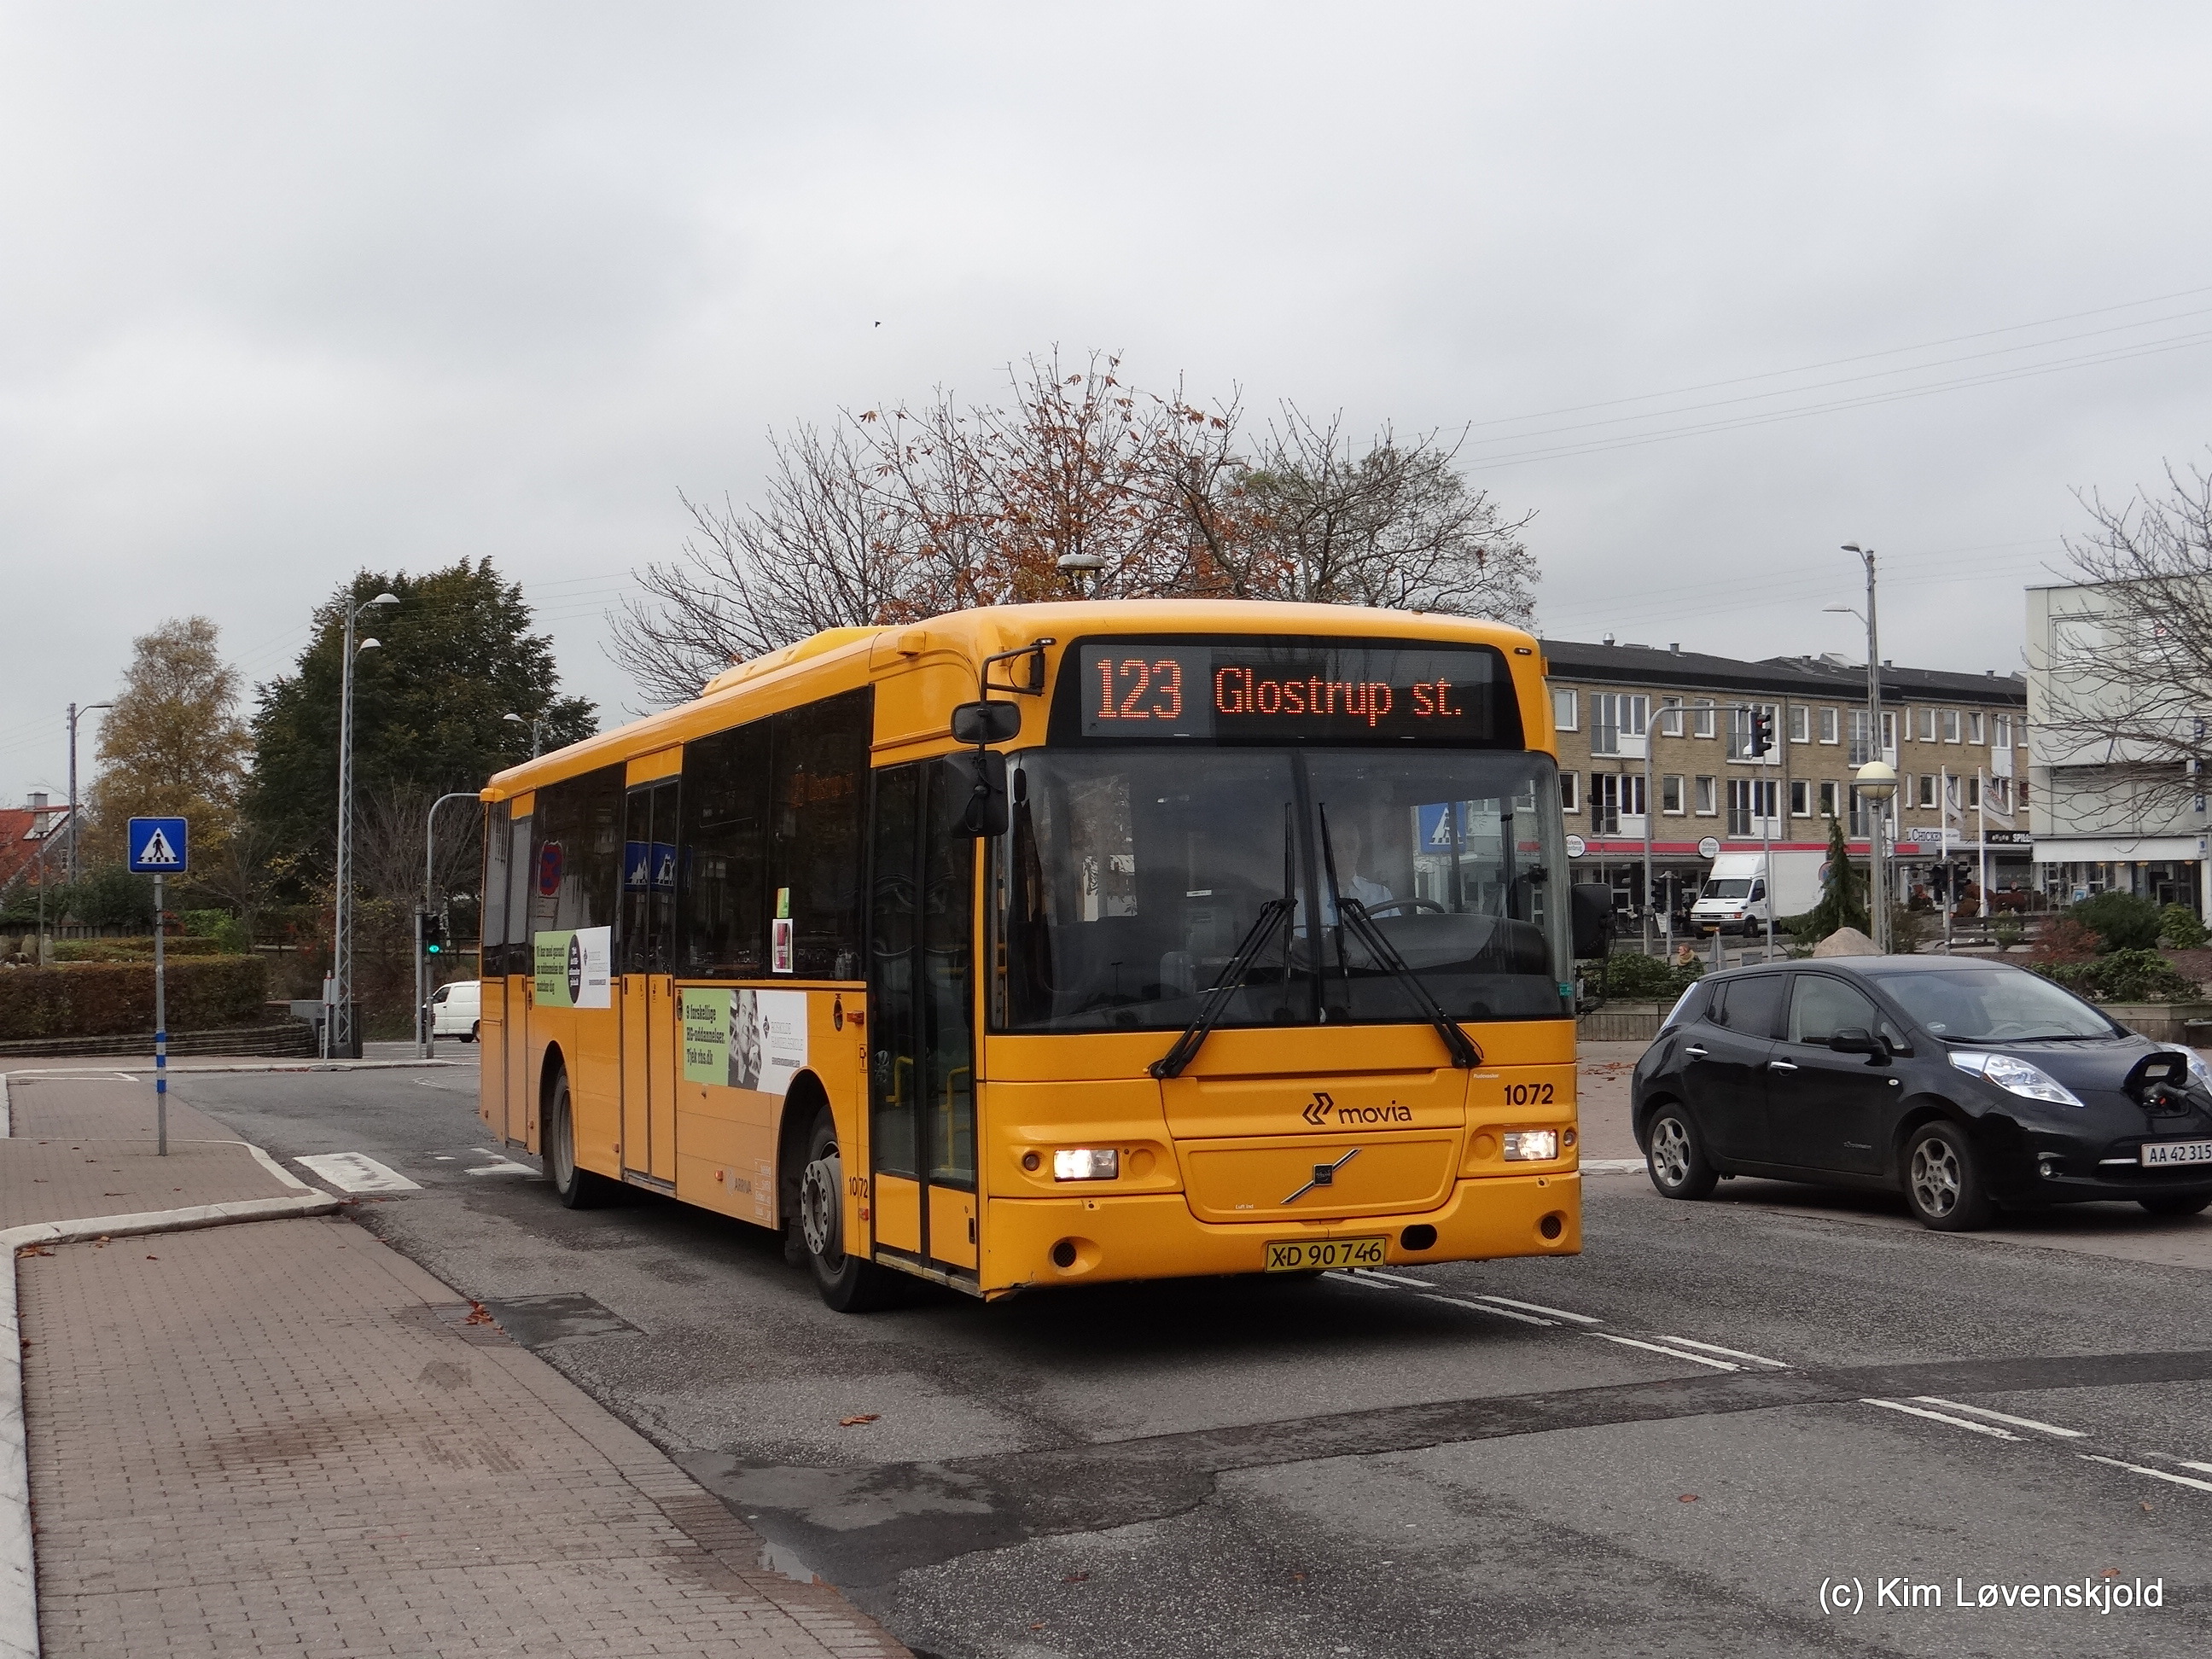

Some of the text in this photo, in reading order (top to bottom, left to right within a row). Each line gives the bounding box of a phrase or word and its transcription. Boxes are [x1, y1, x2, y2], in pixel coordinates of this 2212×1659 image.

[1097, 659, 1182, 719] 123
[1215, 667, 1462, 726] Glostrup st.
[686, 1004, 716, 1023] 9 forskellige
[687, 1047, 697, 1066] Tjek
[1504, 1083, 1554, 1106] 1072
[1338, 1100, 1412, 1125] movia
[2150, 1144, 2212, 1162] AA 42 315
[848, 1175, 868, 1199] 1072
[1271, 1242, 1382, 1267] XD 90 746
